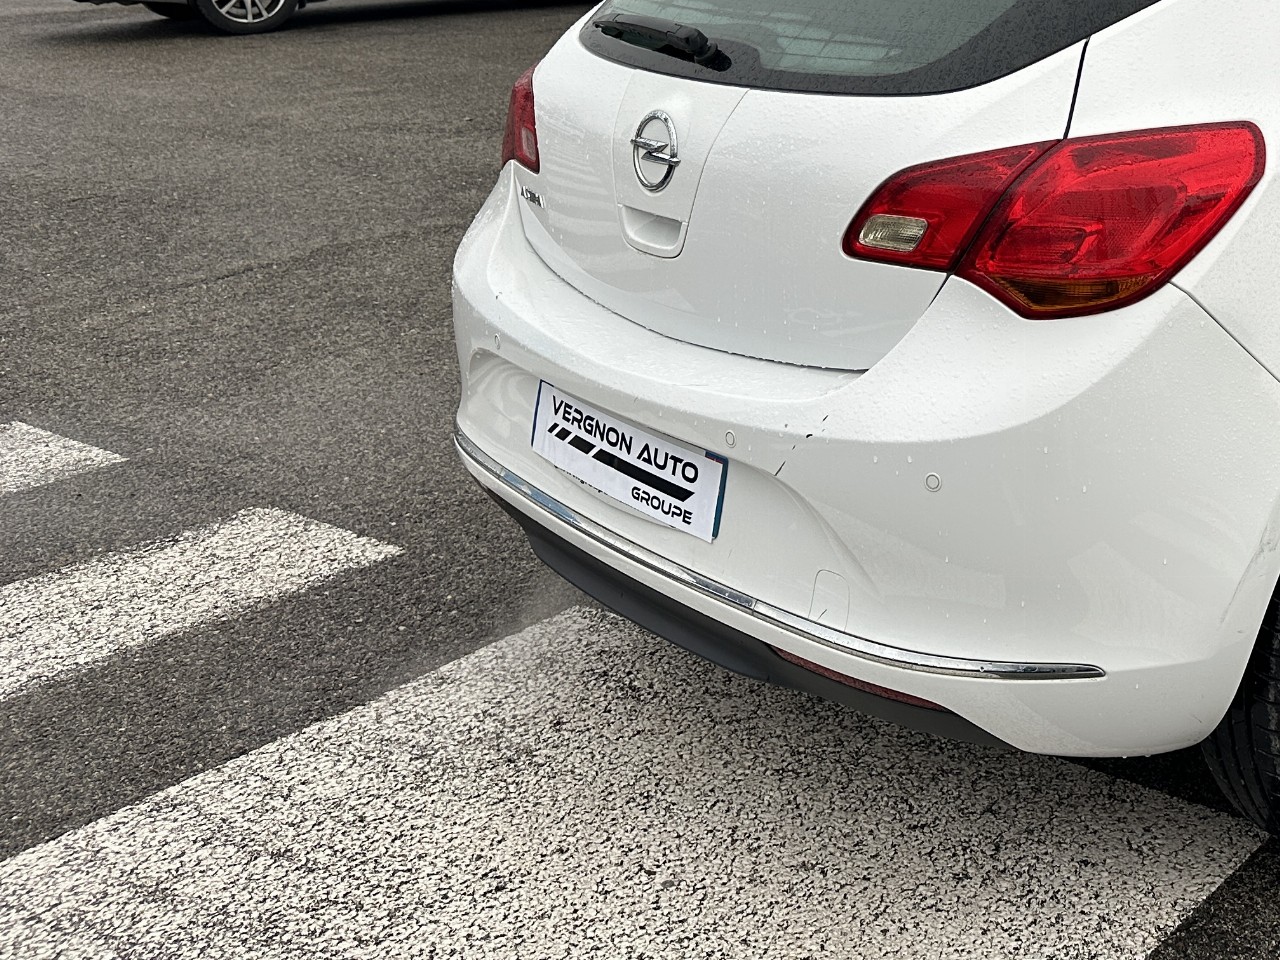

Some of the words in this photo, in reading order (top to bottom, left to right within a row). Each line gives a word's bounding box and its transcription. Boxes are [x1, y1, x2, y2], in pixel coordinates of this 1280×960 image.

[552, 395, 633, 455] VERGNON
[637, 443, 699, 483] AUTO
[631, 486, 693, 525] GROUPE
